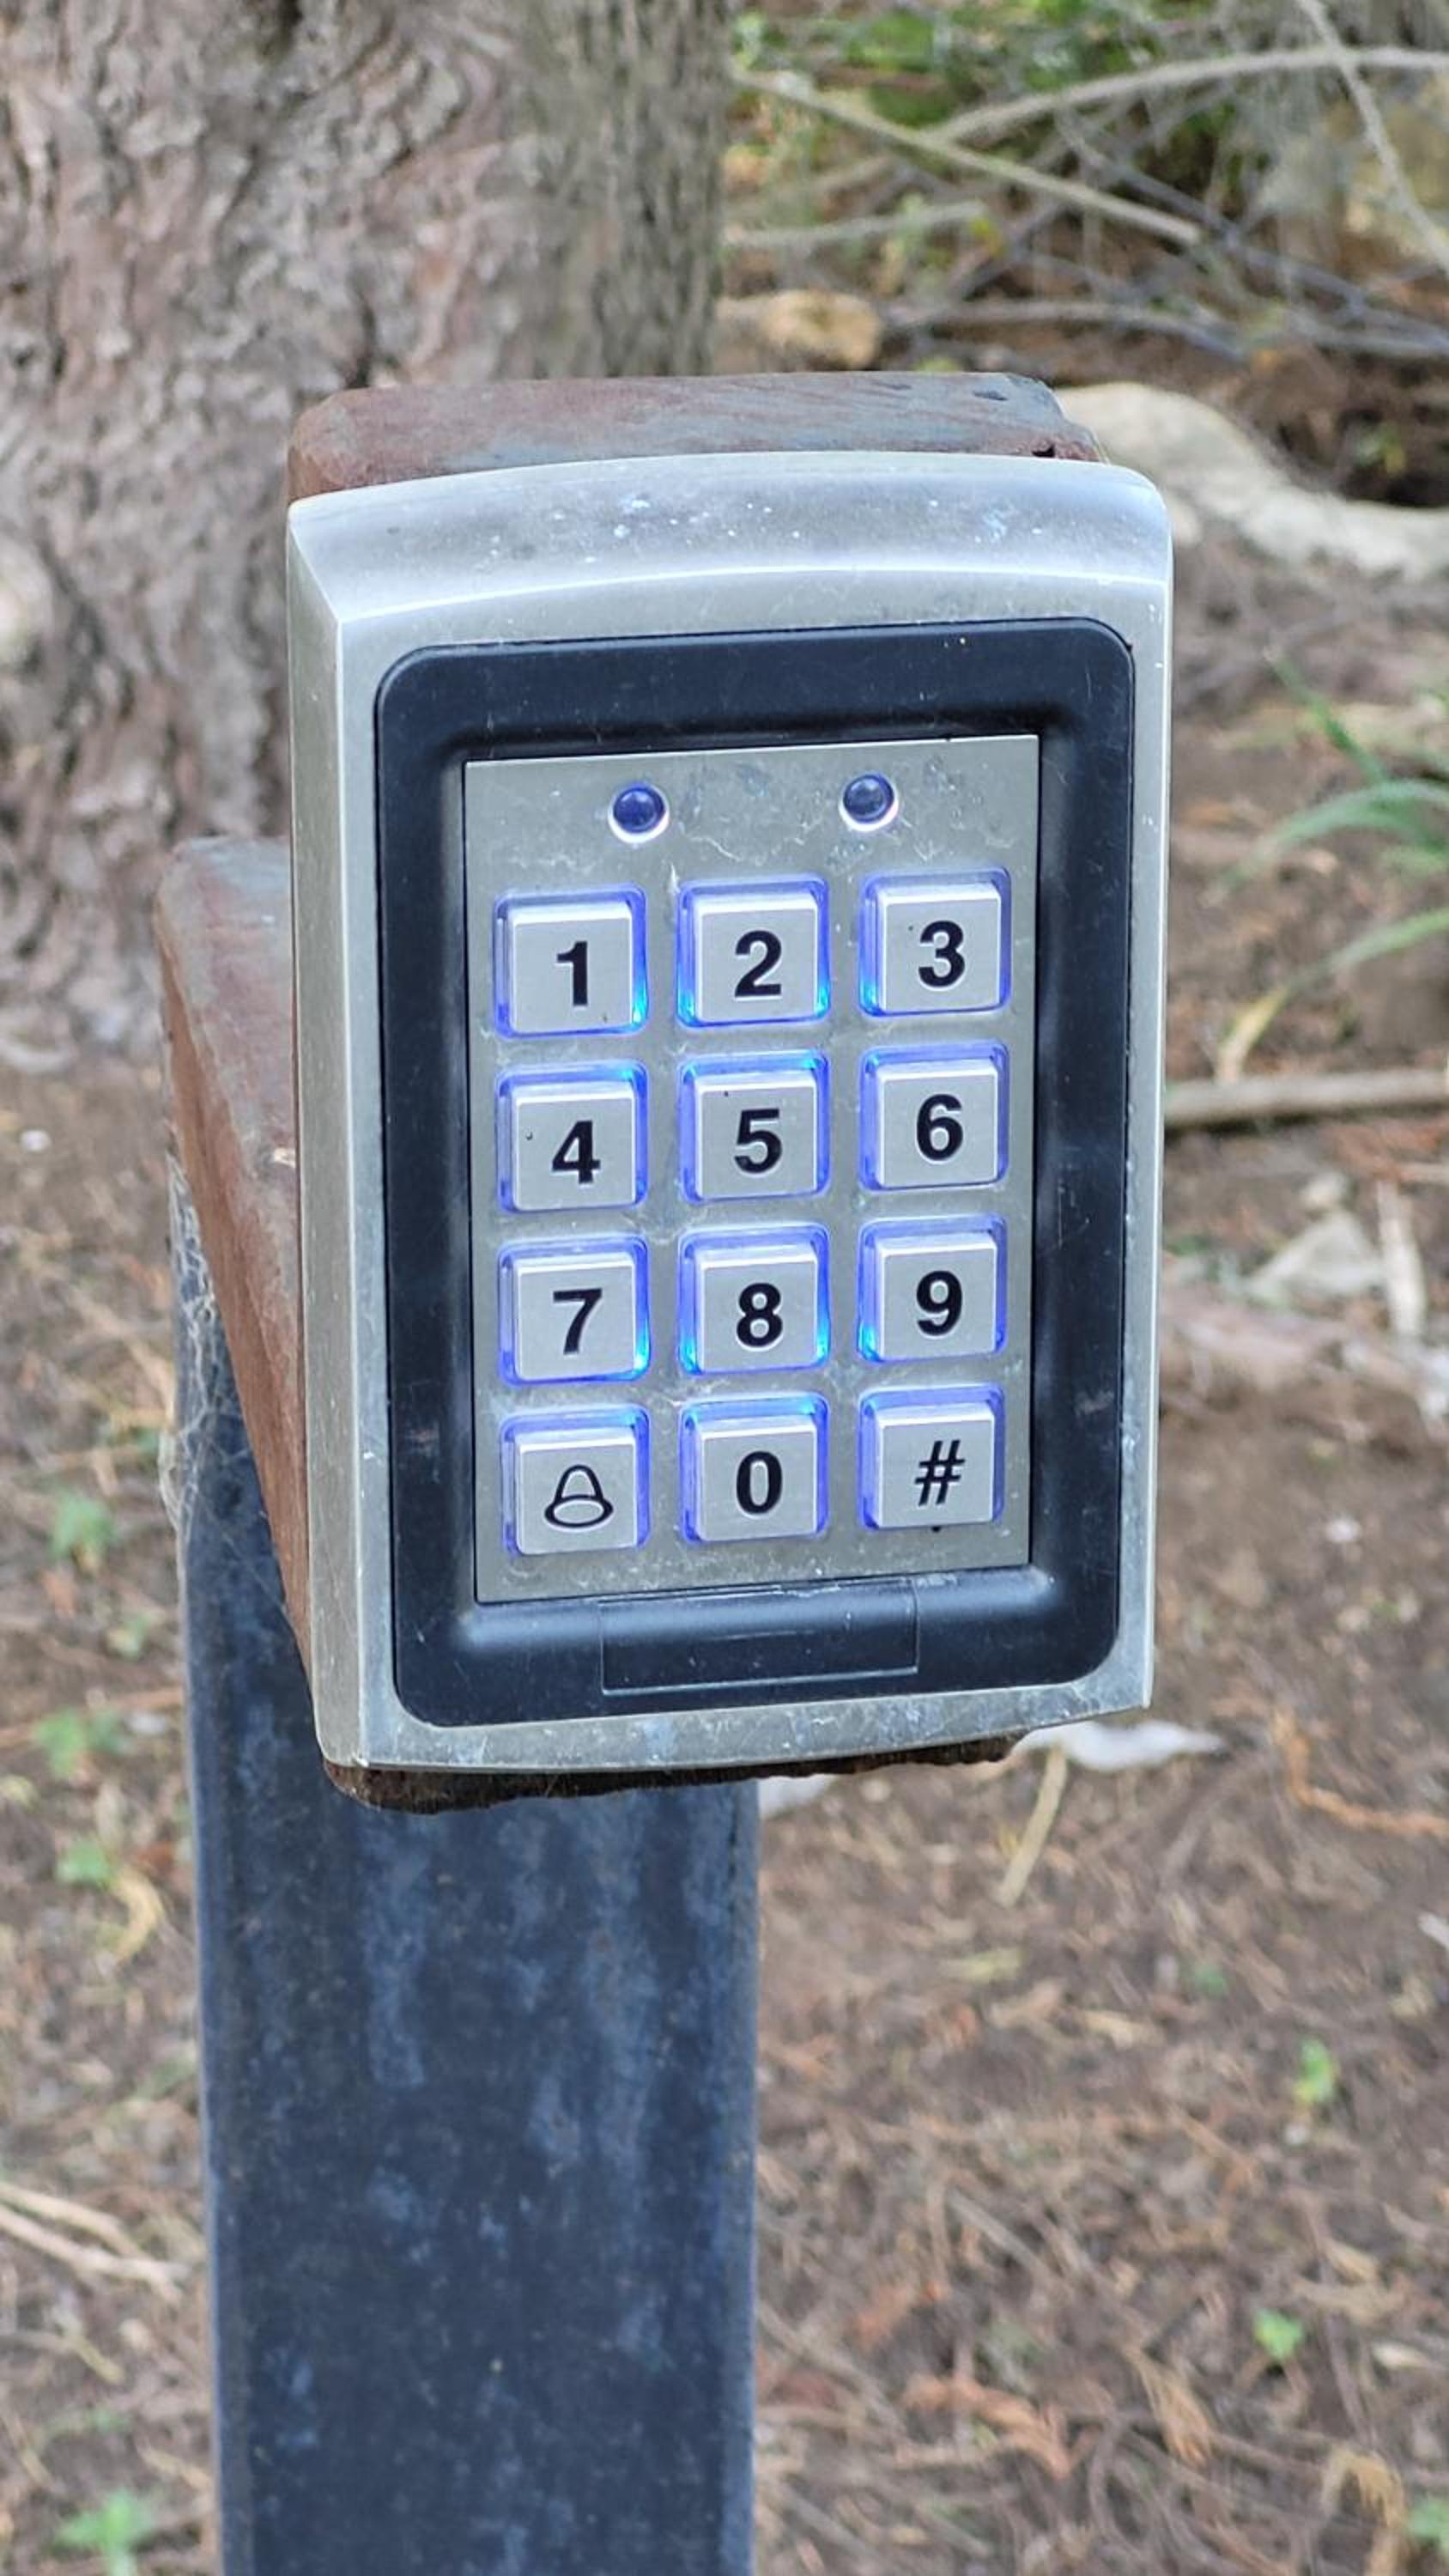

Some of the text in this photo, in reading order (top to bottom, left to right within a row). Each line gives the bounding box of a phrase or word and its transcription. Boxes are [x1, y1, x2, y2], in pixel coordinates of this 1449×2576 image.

[556, 920, 966, 1006] 1 2 3
[551, 1093, 964, 1184] 4 5 6
[552, 1269, 963, 1354] 7 8 9
[735, 1438, 967, 1515] 0 #
